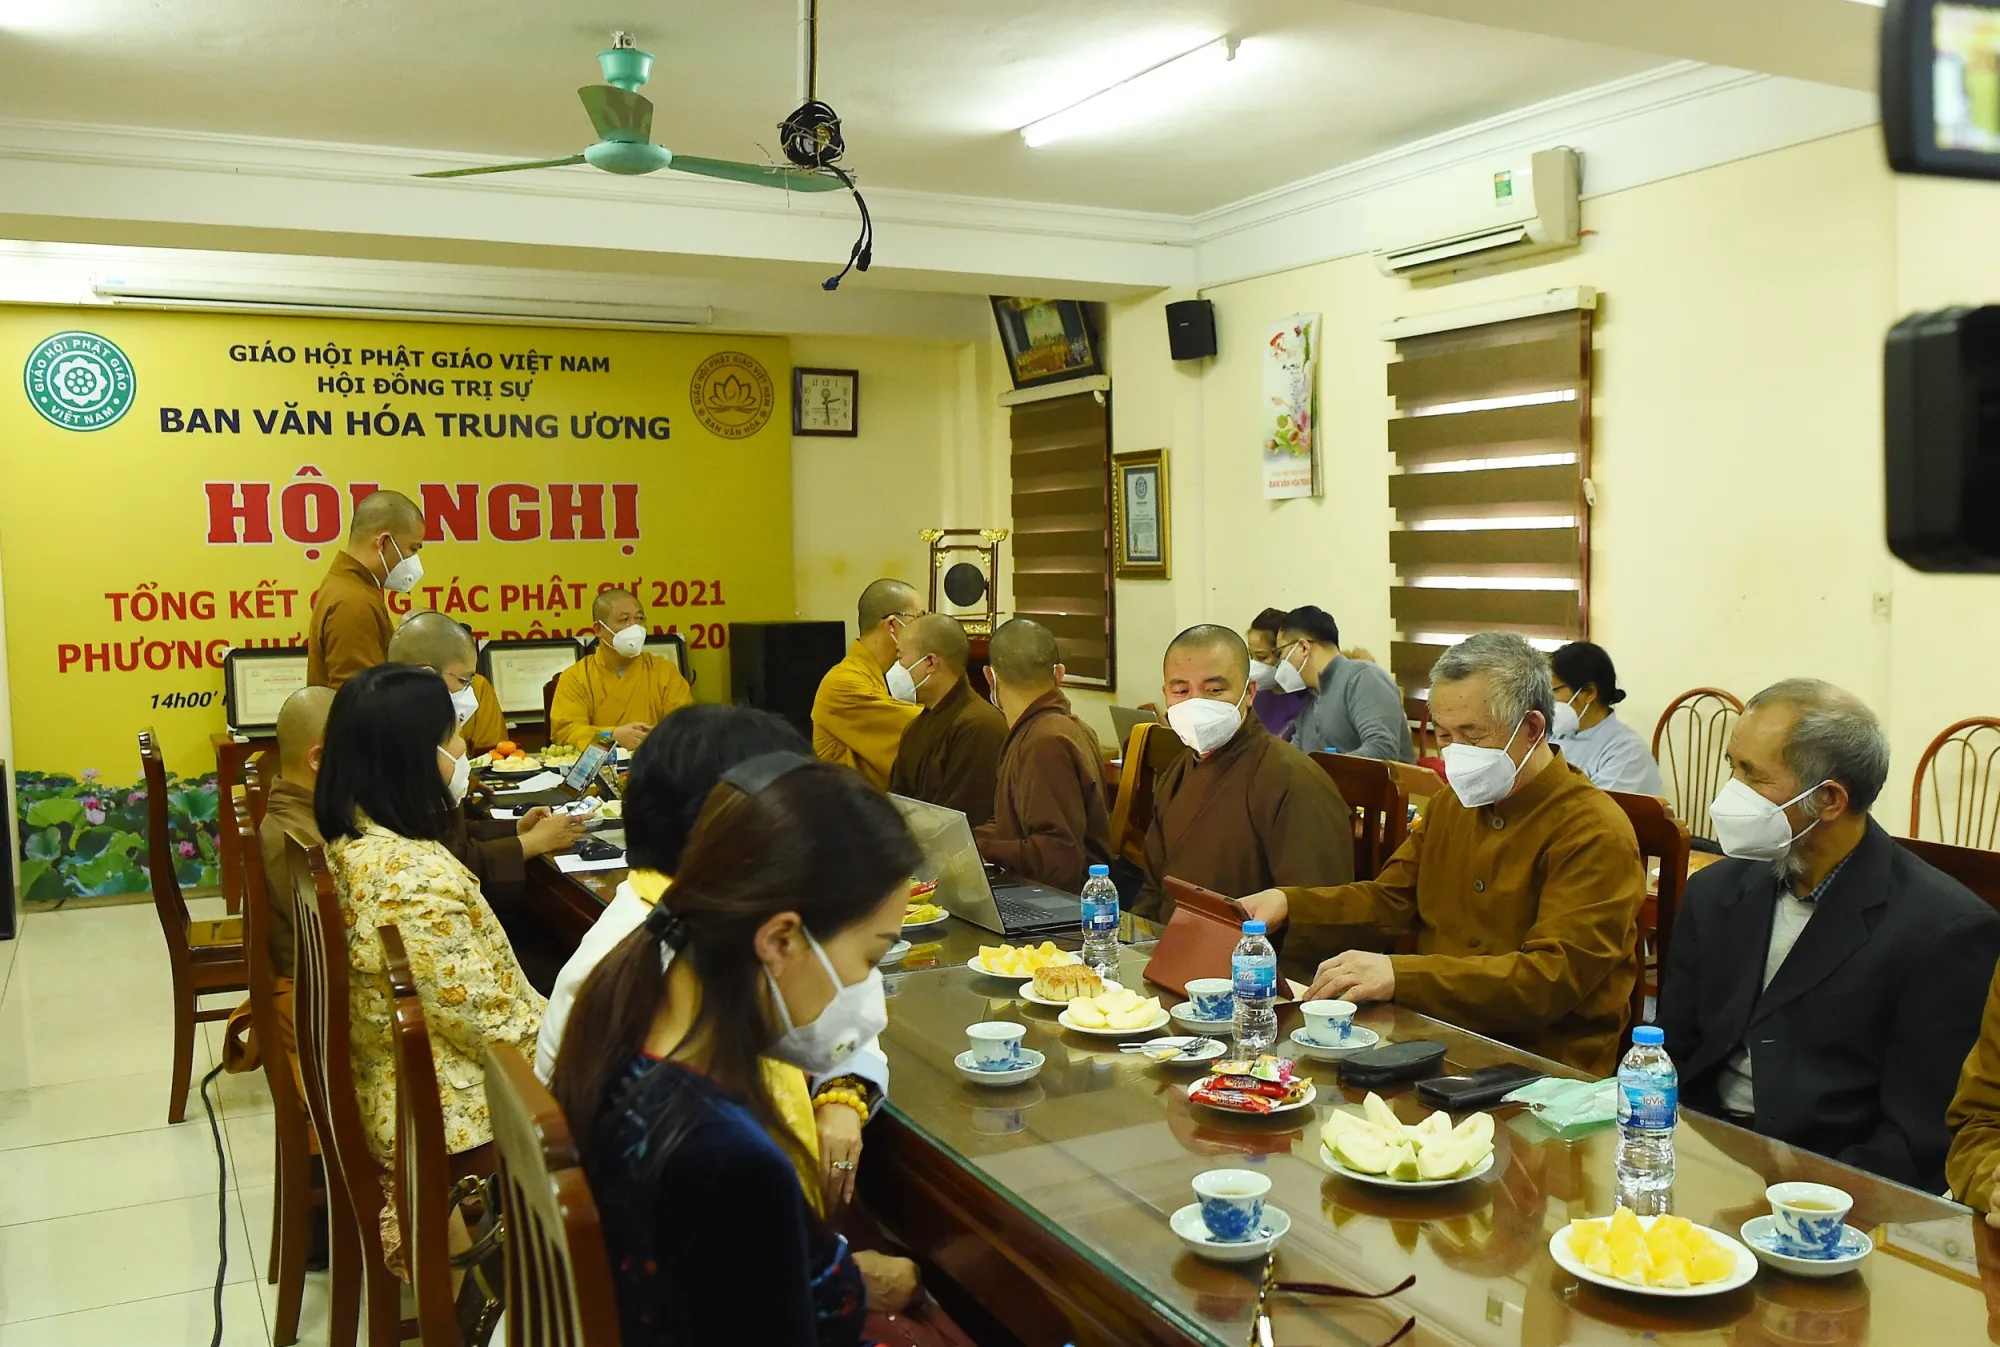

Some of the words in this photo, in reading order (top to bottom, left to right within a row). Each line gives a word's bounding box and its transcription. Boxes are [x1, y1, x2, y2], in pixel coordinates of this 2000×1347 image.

[31, 359, 46, 392] GIÁO
[44, 340, 68, 359] HỘI
[73, 339, 111, 356] PHẬT
[110, 358, 129, 391] GIÁO
[229, 340, 296, 363] GIÁO
[304, 342, 352, 368] HỘI
[361, 344, 425, 371] PHẬT
[431, 347, 493, 369] GIÁO
[500, 349, 553, 374] VIỆT
[560, 355, 610, 373] NAM
[318, 371, 365, 397] HỘI
[373, 372, 445, 396] ĐỒNG
[451, 379, 493, 401] TRỊ
[500, 379, 533, 401] SỰ
[50, 405, 80, 424] VIỆT
[84, 406, 114, 424] NAM
[160, 407, 240, 433] BAN
[253, 401, 332, 435] VĂN
[346, 403, 426, 436] HÓA
[435, 412, 559, 438] TRUNG
[570, 411, 670, 440] ƯƠNG
[420, 482, 641, 557] NGHỊ
[104, 581, 216, 622] TỔNG
[229, 579, 299, 619] KẾT
[422, 576, 489, 613] TÁC
[500, 575, 588, 618] PHẬT
[651, 580, 726, 607] 2021
[57, 635, 232, 673] PHƯƠNG
[689, 622, 726, 649] 20
